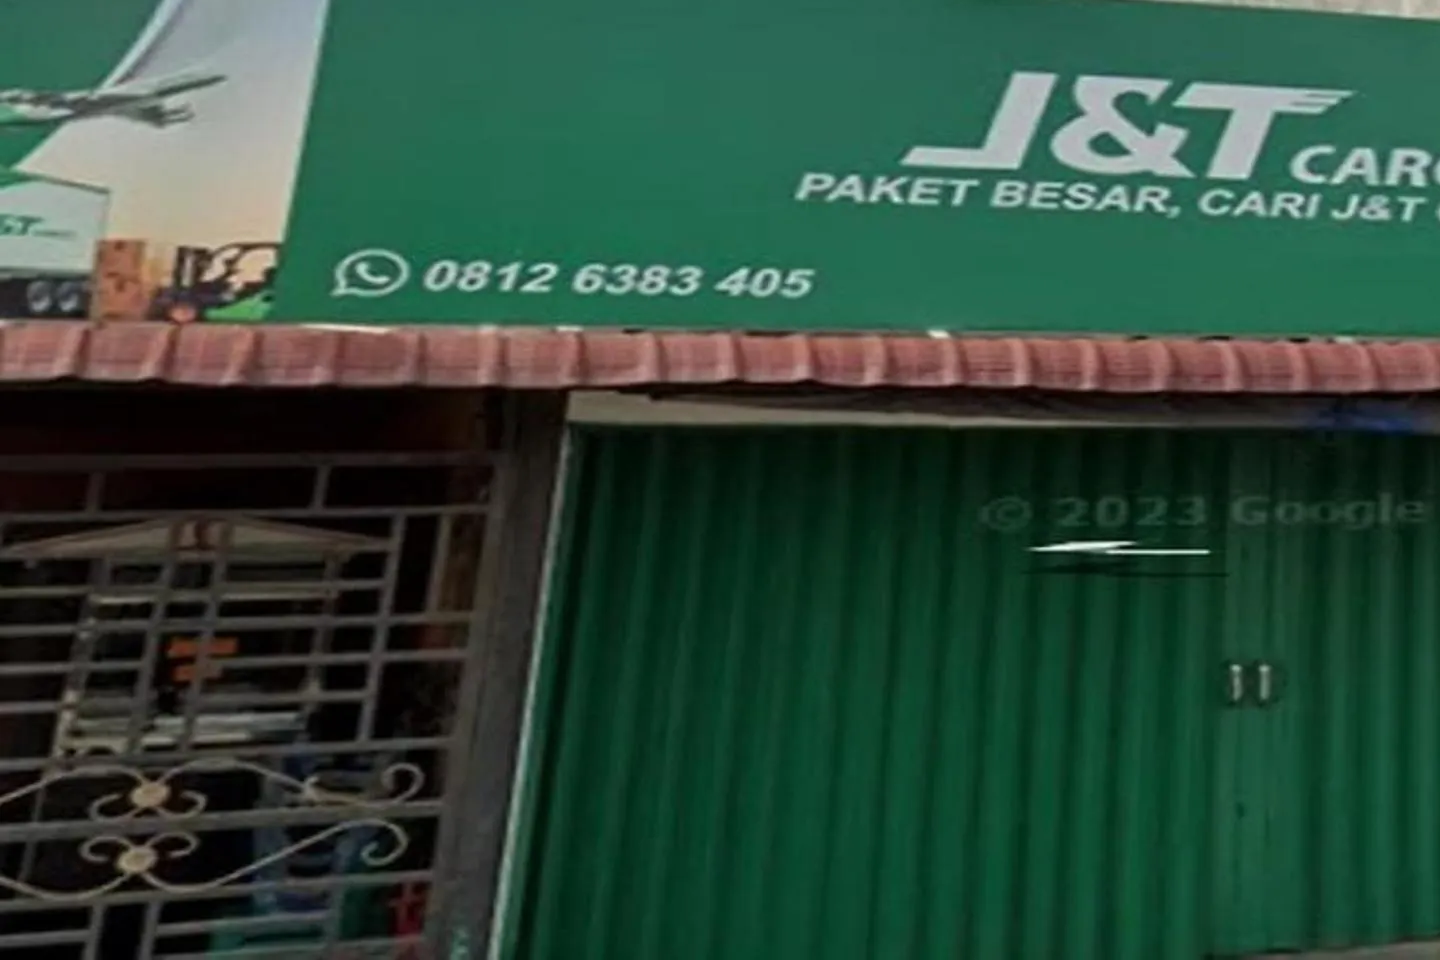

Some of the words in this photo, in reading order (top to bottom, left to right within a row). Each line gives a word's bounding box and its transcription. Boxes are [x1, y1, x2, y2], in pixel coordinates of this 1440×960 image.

[901, 71, 1354, 180] J&T
[795, 172, 977, 207] PAKET
[990, 180, 1181, 218] BESAR,
[1198, 188, 1319, 220] CARI
[1332, 194, 1426, 224] J&T
[423, 259, 558, 293] 0812
[572, 262, 704, 296] 6383
[714, 268, 815, 299] 405
